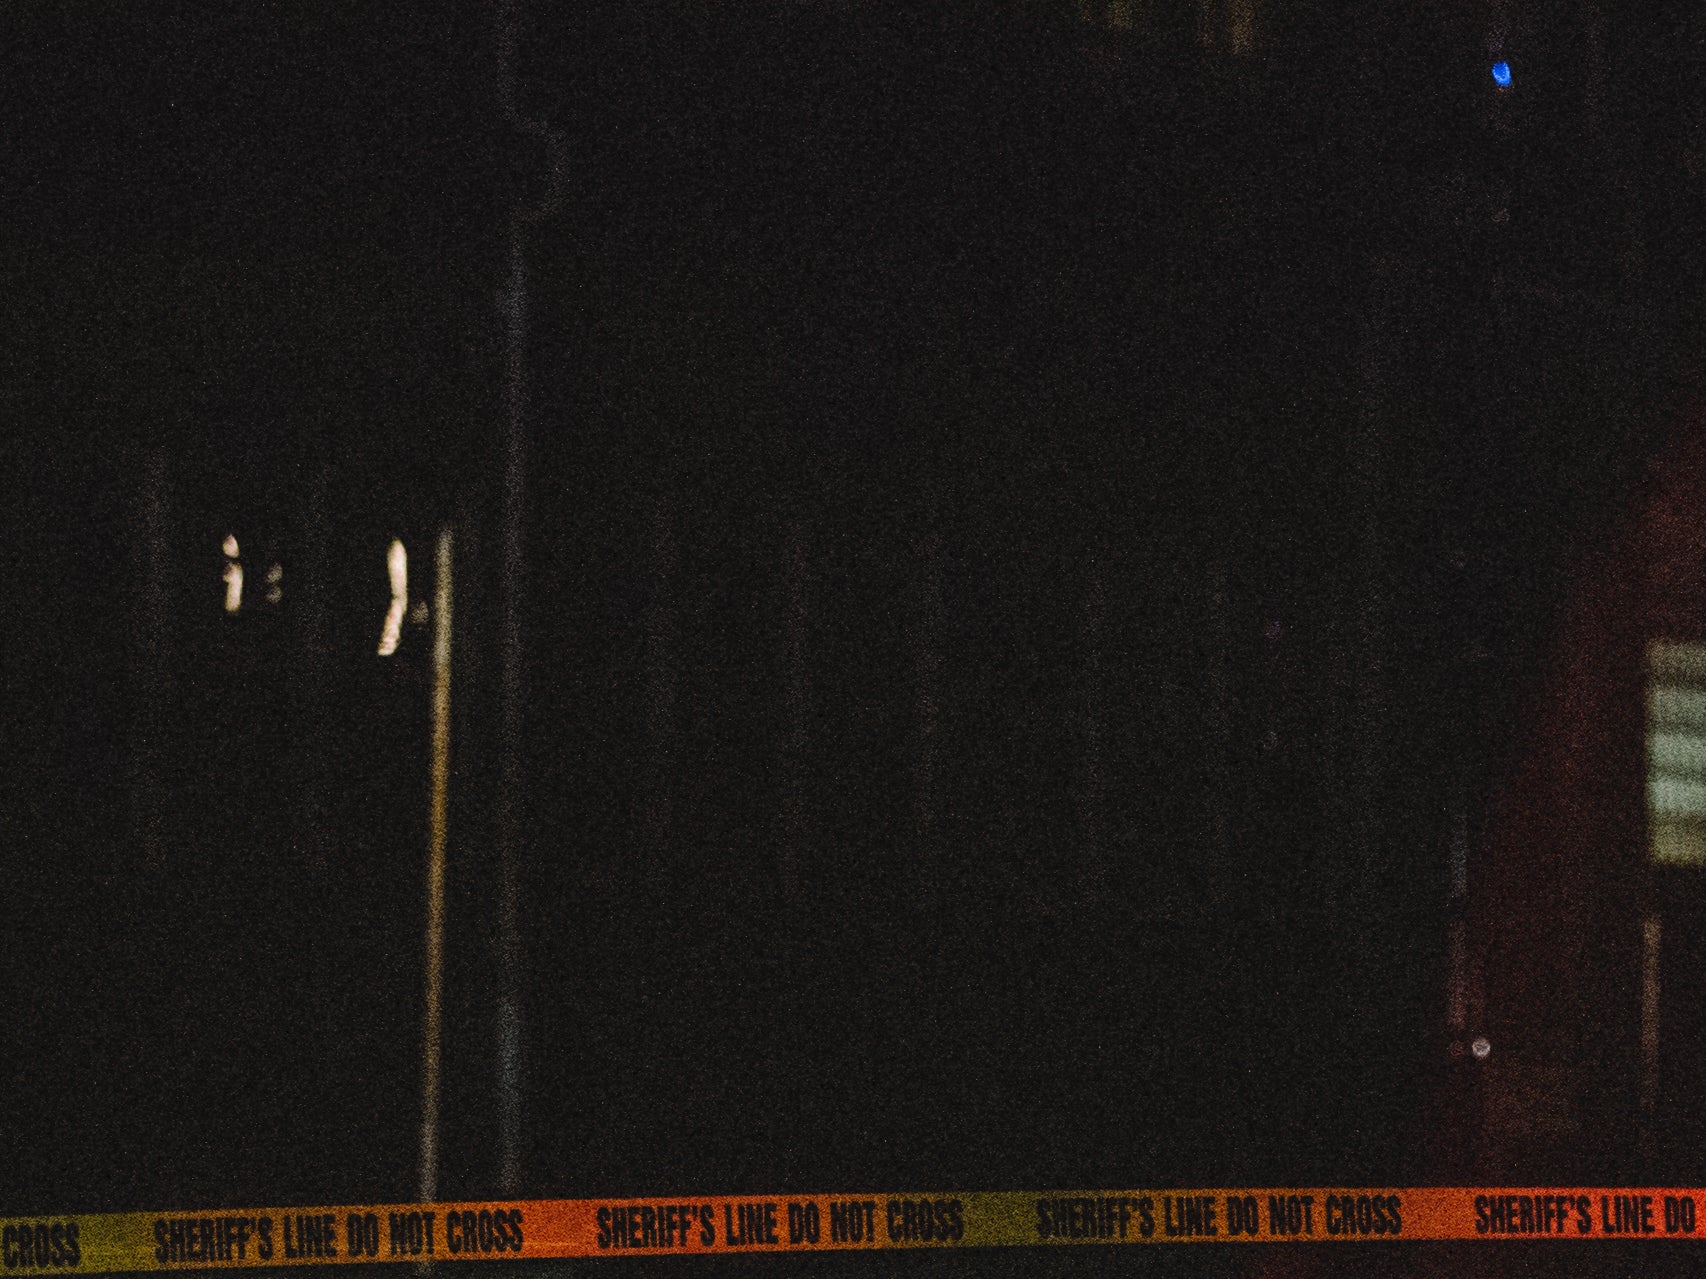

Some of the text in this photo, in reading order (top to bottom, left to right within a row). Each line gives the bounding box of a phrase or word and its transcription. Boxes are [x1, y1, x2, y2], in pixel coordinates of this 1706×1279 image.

[153, 1208, 524, 1265] SHERIFF'S LINE DO NOT CROSS
[595, 1200, 965, 1250] SHERIFF'S LINE DO NOT CROSS
[1035, 1195, 1403, 1240] SHERIFF'S LINE DO NOT CROSS
[1474, 1195, 1593, 1235] SHERIFF'S
[1600, 1195, 1655, 1235] LINE
[1662, 1196, 1697, 1235] DO
[2, 1221, 81, 1270] CROSS
